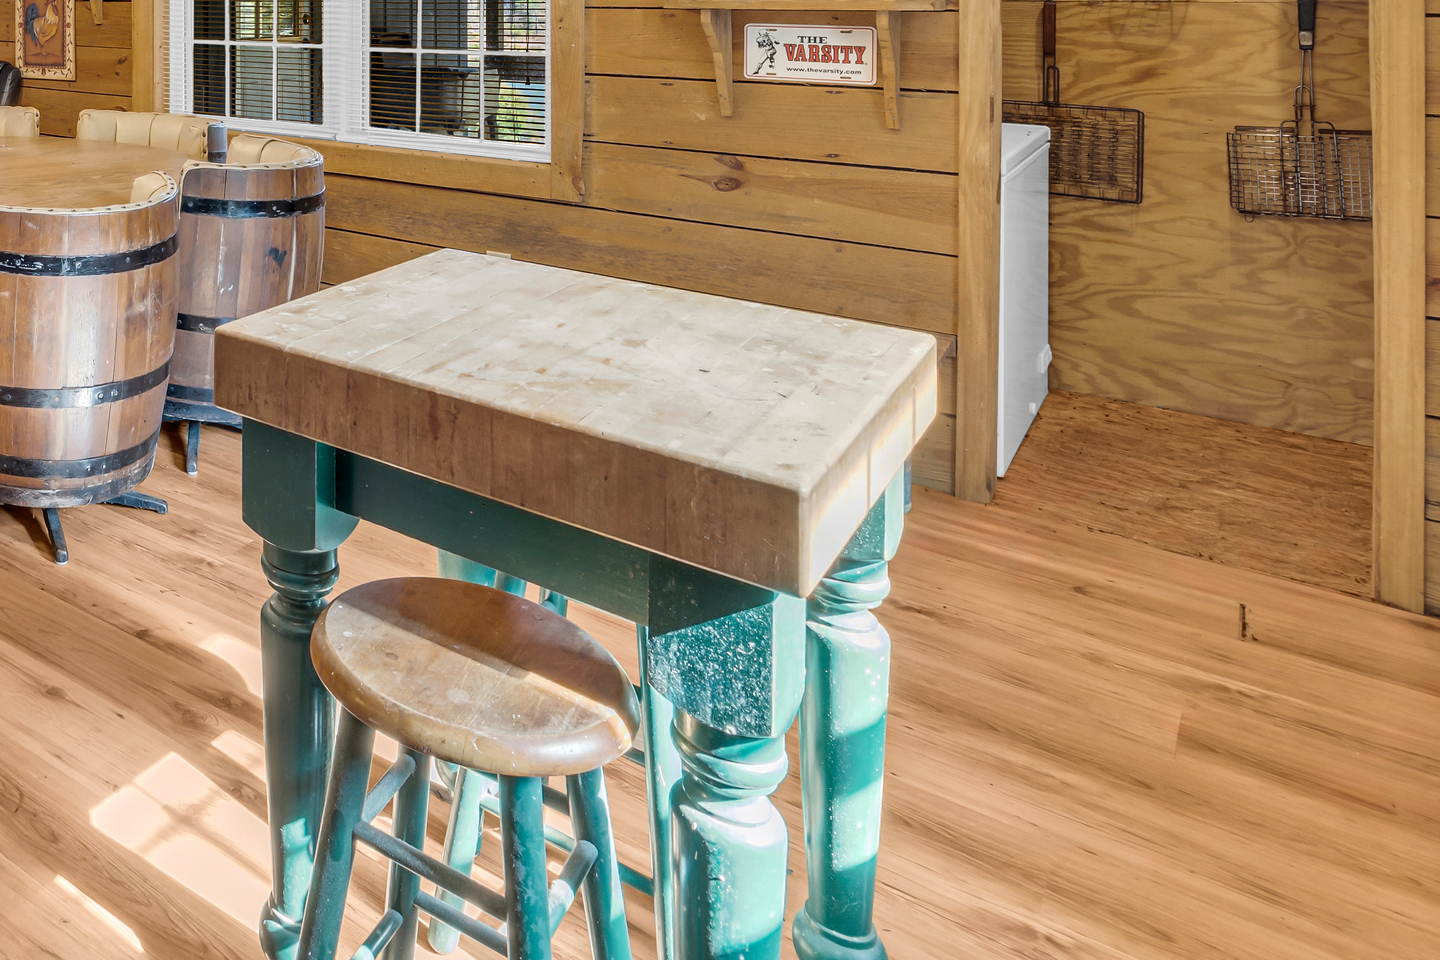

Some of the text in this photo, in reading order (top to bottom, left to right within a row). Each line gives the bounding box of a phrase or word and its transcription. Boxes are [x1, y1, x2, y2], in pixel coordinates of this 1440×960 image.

[797, 35, 828, 44] THE
[783, 43, 867, 65] VARSITY
[786, 67, 862, 76] www.thevarsity.com
